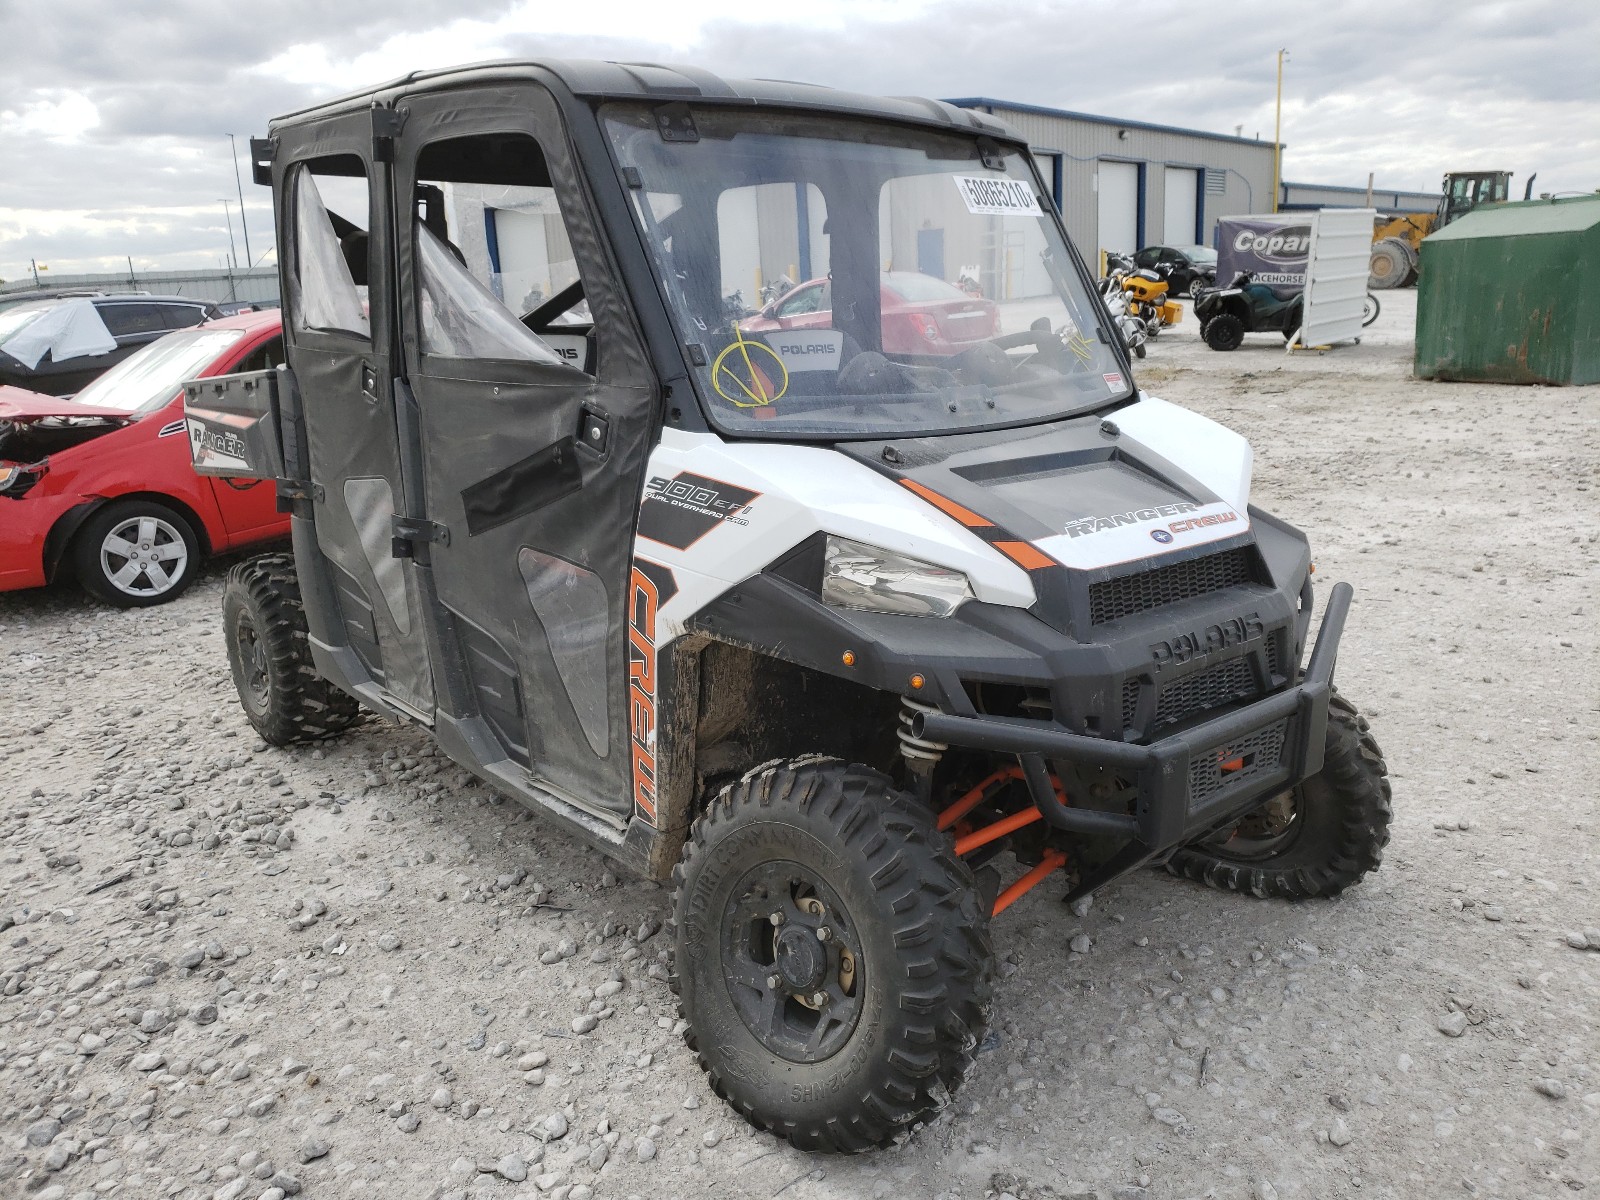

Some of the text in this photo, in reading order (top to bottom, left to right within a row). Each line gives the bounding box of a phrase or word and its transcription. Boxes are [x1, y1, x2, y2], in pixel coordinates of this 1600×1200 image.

[963, 178, 1030, 208] 50865210
[1234, 231, 1311, 256] Copar
[780, 344, 836, 355] POLARIS
[194, 428, 245, 458] RANGER
[645, 492, 750, 527] DUAL OVERHEAD CAM
[646, 475, 753, 515] 900 EFI
[1064, 502, 1198, 539] RANGER
[1168, 511, 1238, 534] CREW
[1149, 612, 1264, 674] POLARIS
[630, 566, 659, 829] CREW
[692, 866, 719, 912] DIRT
[790, 1080, 825, 1103] NHS
